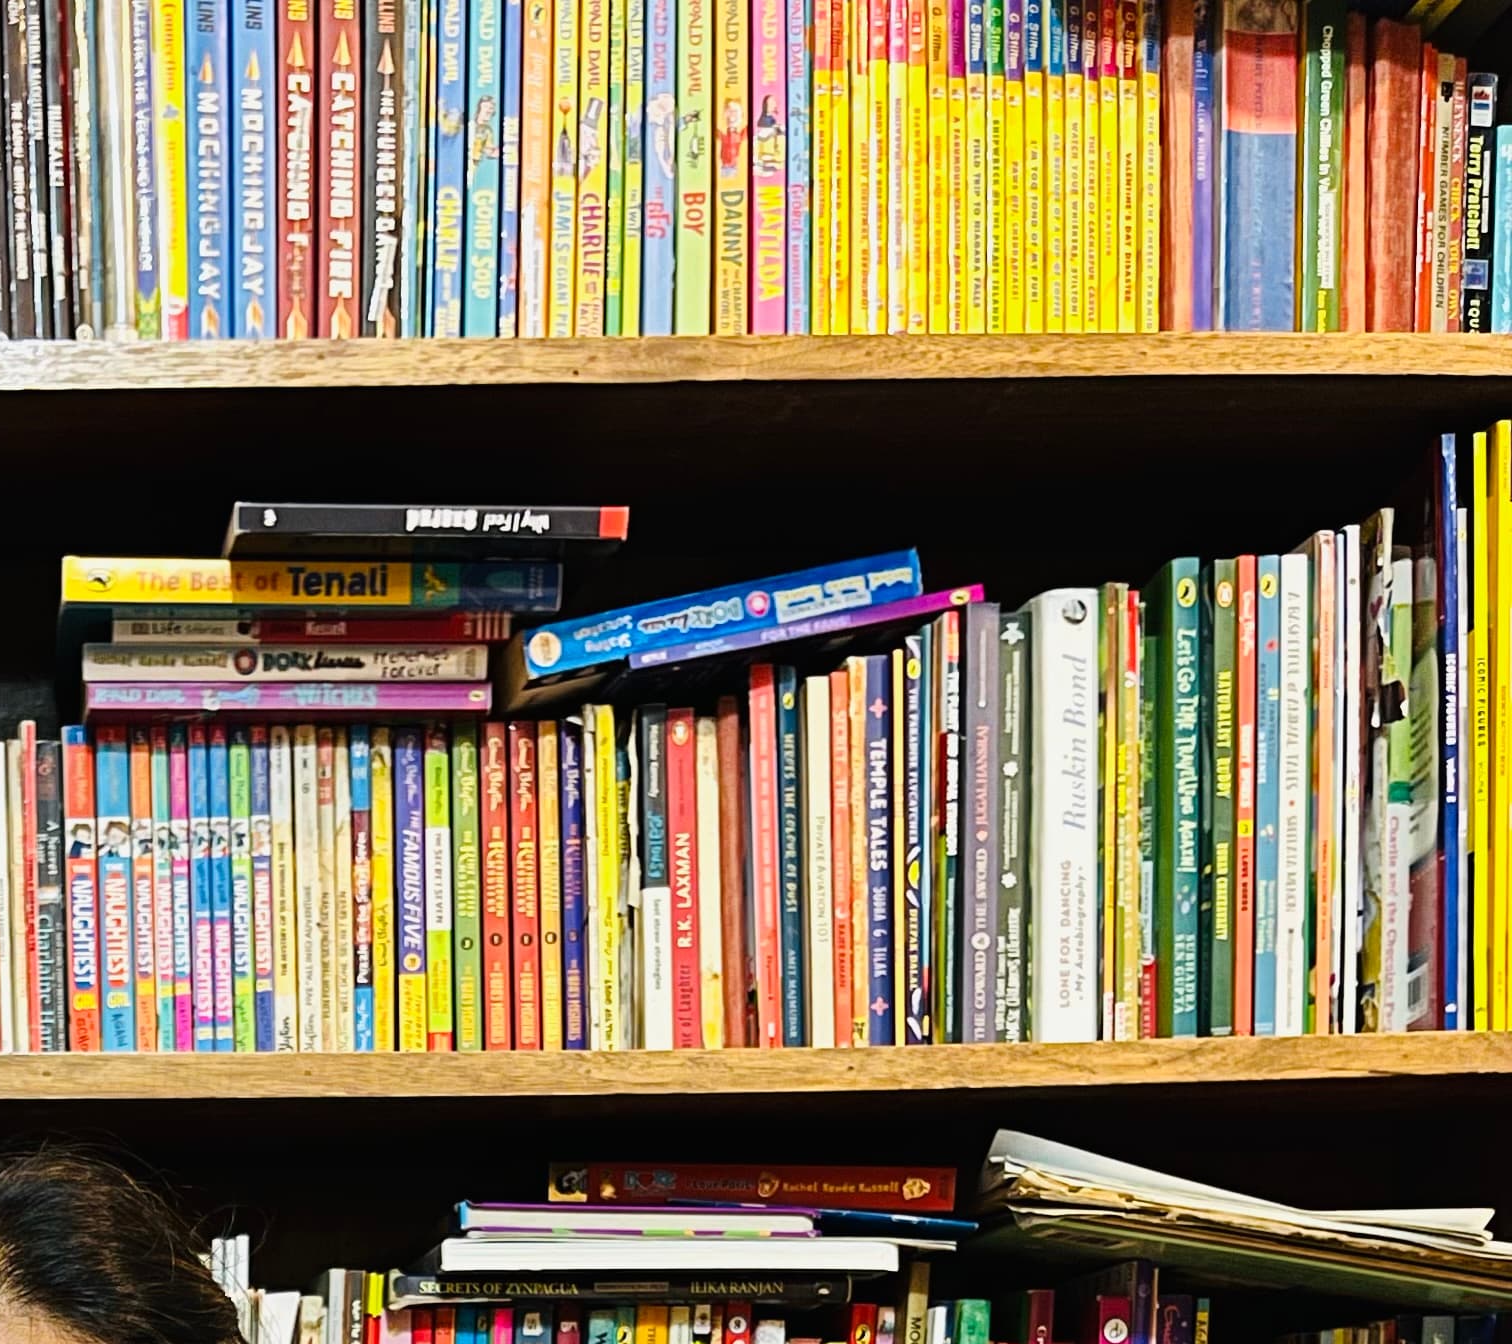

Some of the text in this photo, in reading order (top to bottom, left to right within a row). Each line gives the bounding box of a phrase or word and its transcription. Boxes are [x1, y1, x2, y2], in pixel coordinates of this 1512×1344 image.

[241, 88, 265, 297] MOCKINGJAY
[329, 71, 356, 299] CATCHING FIRE
[683, 191, 707, 237] BOY
[719, 189, 745, 266] DANNY
[758, 184, 786, 302] MATILDA
[287, 564, 389, 597] Tenali
[869, 738, 887, 871] TEMPLE TALES
[676, 833, 691, 948] R.K. LAXMAN
[419, 1280, 579, 1295] SECRETS OF ZYNPAGUA
[690, 1281, 784, 1295] ILIKA RANJAN
